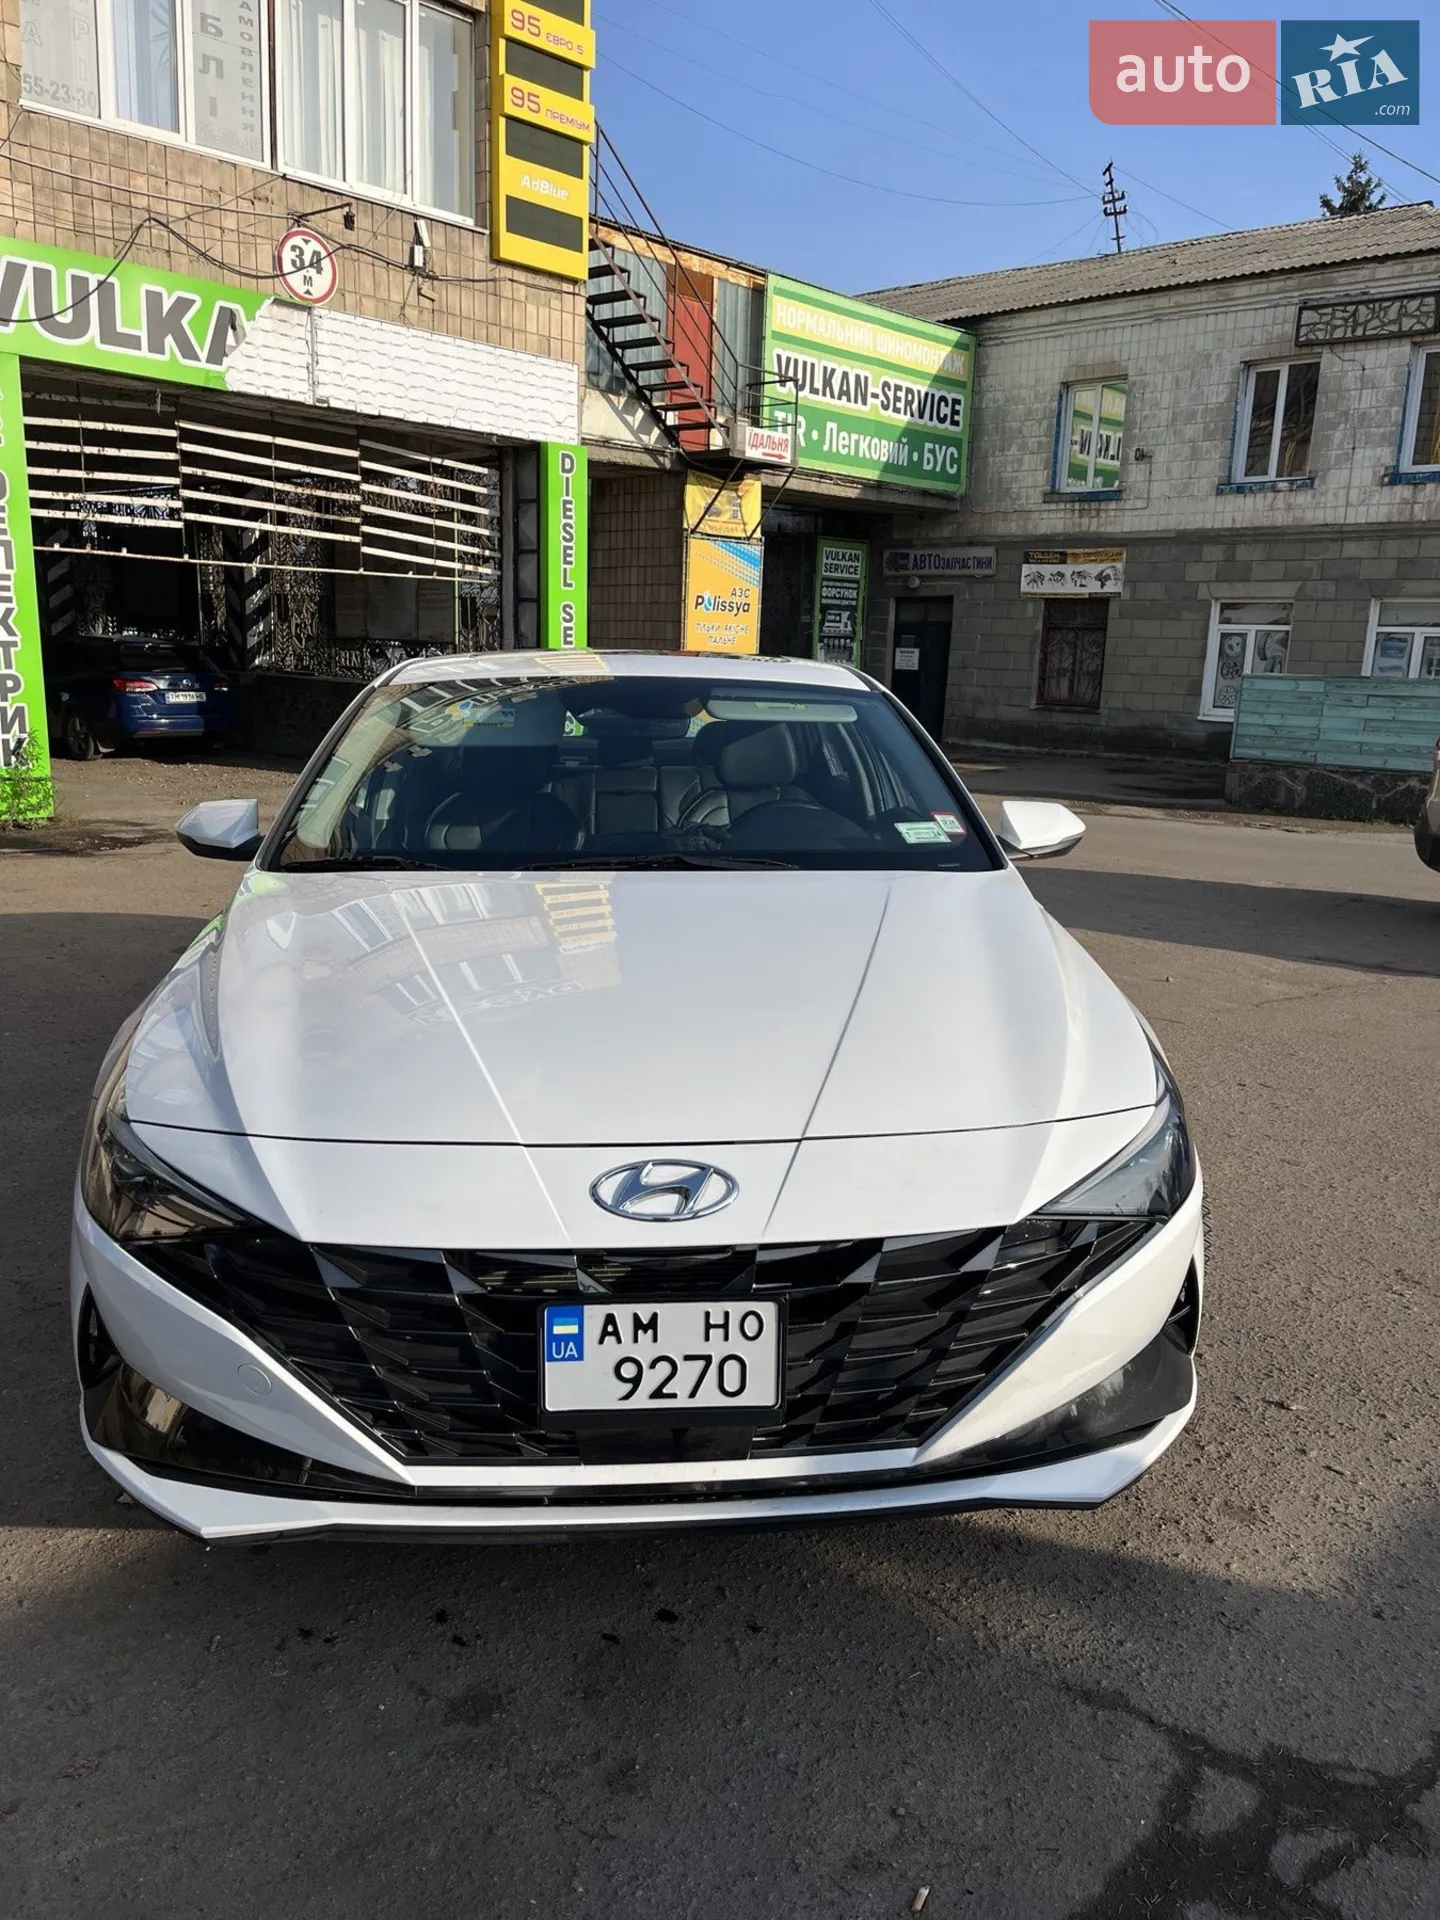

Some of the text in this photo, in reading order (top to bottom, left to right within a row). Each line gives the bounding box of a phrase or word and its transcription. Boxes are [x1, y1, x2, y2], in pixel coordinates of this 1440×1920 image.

[511, 9, 541, 37] 95
[511, 87, 591, 133] 95 ПРЕМІУМ
[521, 175, 569, 201] AdBlue
[776, 303, 964, 375] НОРМАЛЬНИЙ ШИНОМОНТАЖ
[776, 353, 962, 427] VULKAN-SERVICE
[748, 428, 789, 453] ЇДАЛЬНЯ
[823, 422, 909, 467] Легковий
[922, 443, 959, 475] БУС
[561, 452, 575, 588] DIESEL
[824, 563, 860, 575] SERVICE
[825, 550, 861, 563] VULKAN
[821, 587, 857, 599] ФОРСУНОК
[598, 1312, 660, 1345] AM
[552, 1342, 579, 1359] UA
[613, 1353, 748, 1402] 9270
